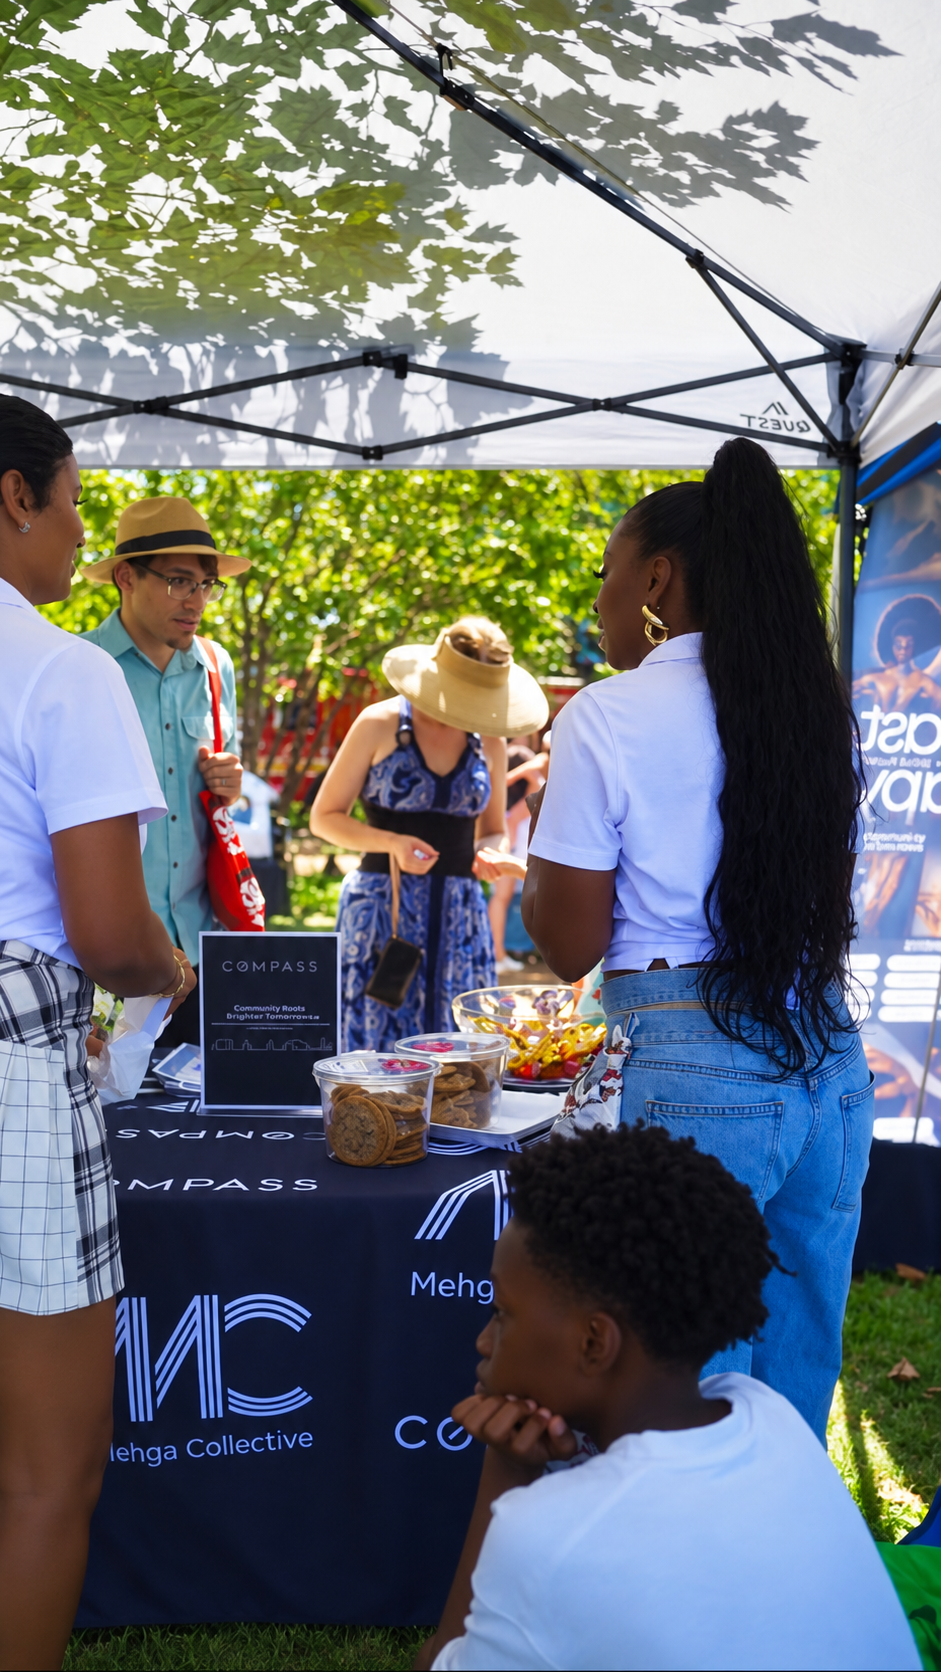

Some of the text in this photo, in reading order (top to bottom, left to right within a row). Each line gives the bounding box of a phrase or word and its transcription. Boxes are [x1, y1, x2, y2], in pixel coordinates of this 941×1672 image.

[233, 1004, 306, 1013] Community Roots
[106, 1128, 326, 1141] COMPAS
[112, 1178, 318, 1192] MPASS
[411, 1271, 495, 1305] Mehg
[110, 1429, 314, 1467] ehga Collective
